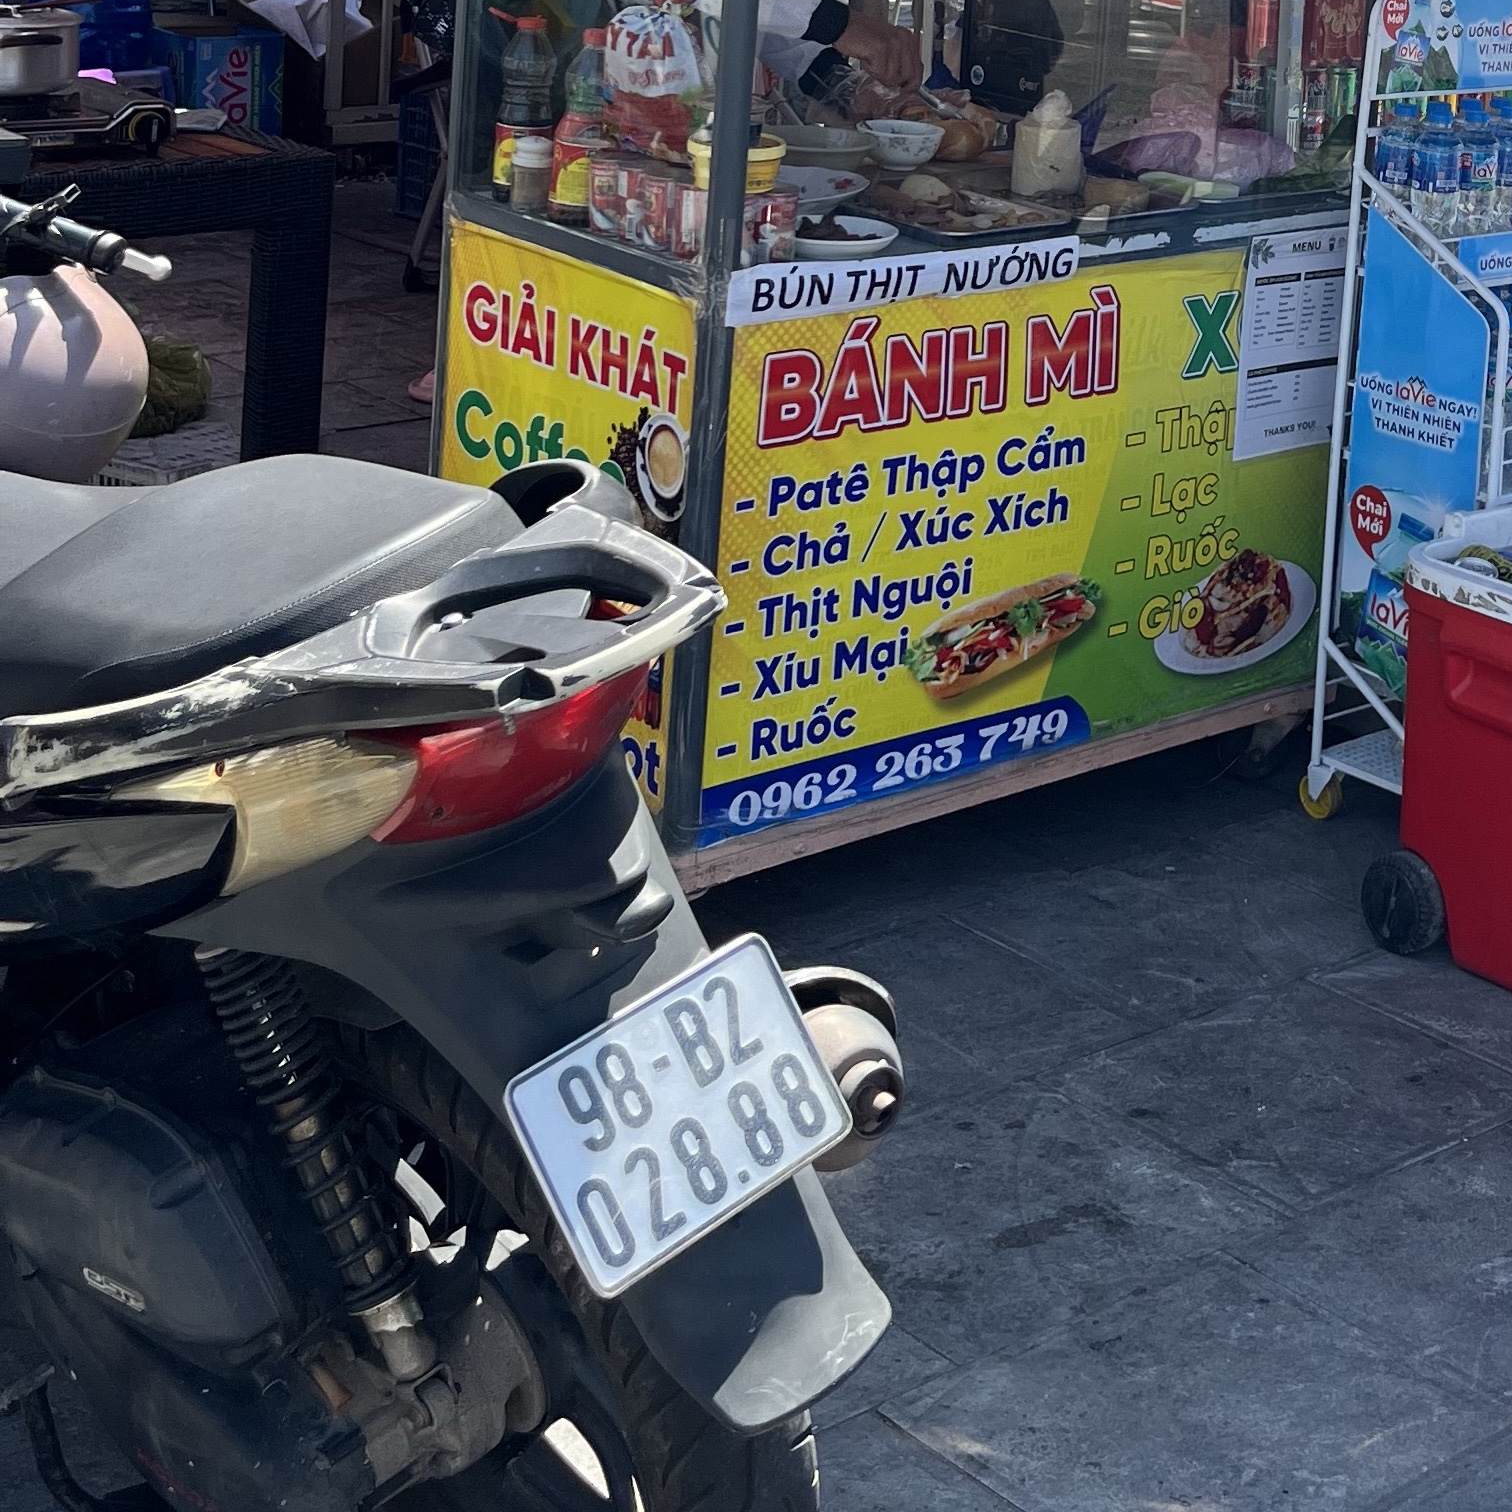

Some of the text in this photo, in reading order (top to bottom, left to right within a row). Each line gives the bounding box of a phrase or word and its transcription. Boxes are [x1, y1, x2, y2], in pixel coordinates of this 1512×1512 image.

[1386, 0, 1407, 12] Chai
[1387, 12, 1405, 25] Mới
[1468, 20, 1499, 38] UỐNG
[219, 44, 250, 126] aVie
[1472, 163, 1496, 179] laV
[1292, 241, 1322, 254] MENU
[1479, 253, 1512, 271] UỐNG
[751, 245, 1074, 313] BÚN THỊT NƯỚNG
[464, 279, 688, 417] GIẢI KHÁT
[756, 315, 1009, 449] BÁNH
[1024, 285, 1121, 406] MÌ
[1360, 375, 1478, 420] UỐNG laVie NGAY!
[1385, 400, 1420, 422] THIÊN
[1422, 408, 1462, 433] NHIÊN
[1263, 419, 1316, 437] THANKS YOU!
[1374, 415, 1455, 450] THANH KHIẾT
[767, 462, 870, 518] Patê
[882, 450, 985, 499] Thập
[996, 425, 1086, 477] Cẩm
[1149, 469, 1219, 524] Lạc
[1355, 493, 1388, 518] Chai
[1357, 513, 1384, 537] Mới
[762, 522, 851, 576] Chả
[895, 505, 974, 552] Xúc
[1142, 514, 1240, 581] Ruốc
[758, 585, 840, 639] Thịt
[852, 557, 974, 621] Nguội
[1137, 586, 1205, 640] Giò
[751, 651, 819, 701] Xíu
[833, 626, 910, 682] Mại
[750, 695, 858, 763] Ruốc
[727, 709, 1070, 827] 0962 263 749
[557, 975, 765, 1153] 98-B2
[576, 1052, 827, 1268] 028.88
